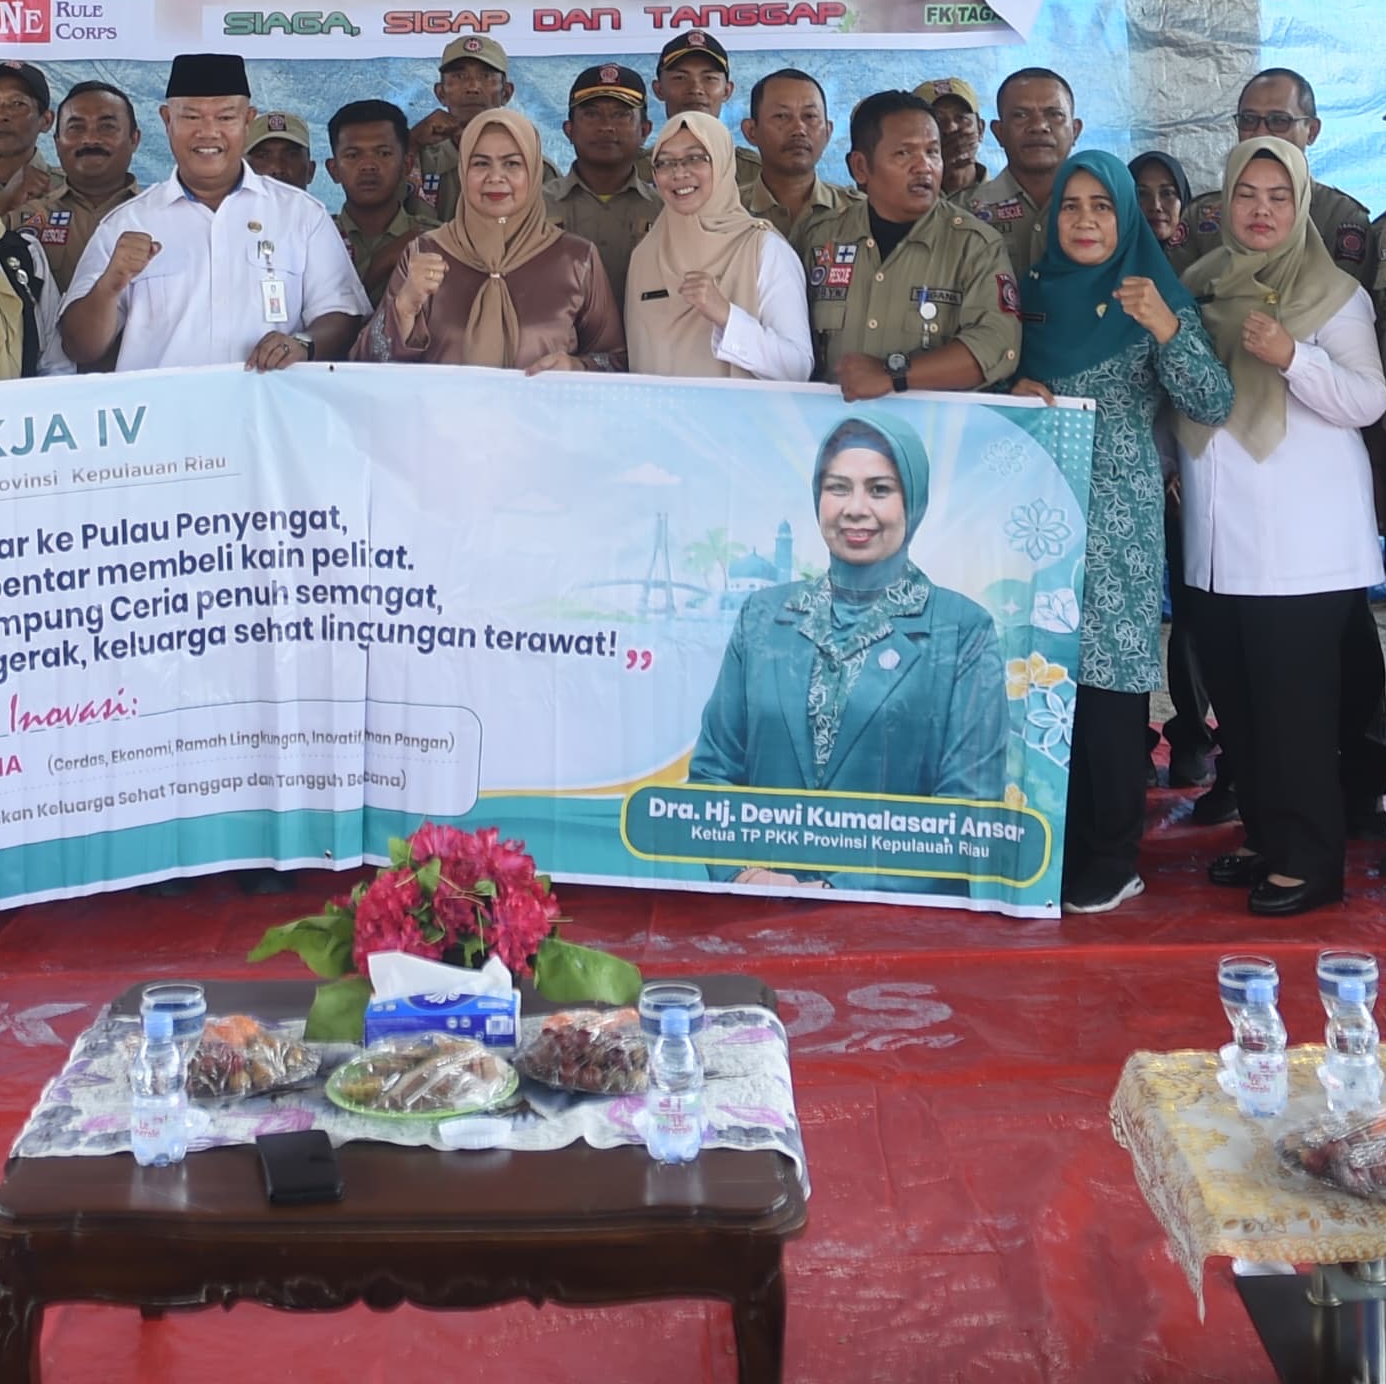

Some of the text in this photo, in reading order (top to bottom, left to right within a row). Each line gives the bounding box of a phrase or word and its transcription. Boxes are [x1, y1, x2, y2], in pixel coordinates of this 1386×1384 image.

[223, 0, 848, 37] SIAGA, SIGAP DAN TANGGAP
[926, 6, 953, 24] FK
[97, 404, 147, 448] IV
[71, 459, 178, 485] Kepulauan
[184, 454, 227, 474] Riau
[36, 528, 74, 554] ke
[80, 515, 170, 551] Pulau
[175, 504, 349, 545] Penyengat,
[97, 542, 234, 587] membeli
[241, 541, 305, 571] kain
[109, 586, 189, 622] Ceria
[195, 578, 290, 617] penuh
[93, 624, 227, 666] keluarga
[234, 615, 315, 647] sehat
[483, 623, 618, 659] terawat!
[175, 733, 227, 754] Ramah
[394, 731, 455, 754] Pangan)
[37, 794, 115, 818] Keluarga
[117, 785, 166, 806] Sehat
[168, 776, 243, 797] Tanggap
[247, 772, 275, 788] dan
[277, 772, 343, 791] Tangguh
[648, 796, 1025, 843] Dra. Hj. Dewi Kumalasari Ansar
[691, 826, 990, 859] Ketua TP PKK Provinsi Kepulauan Riau
